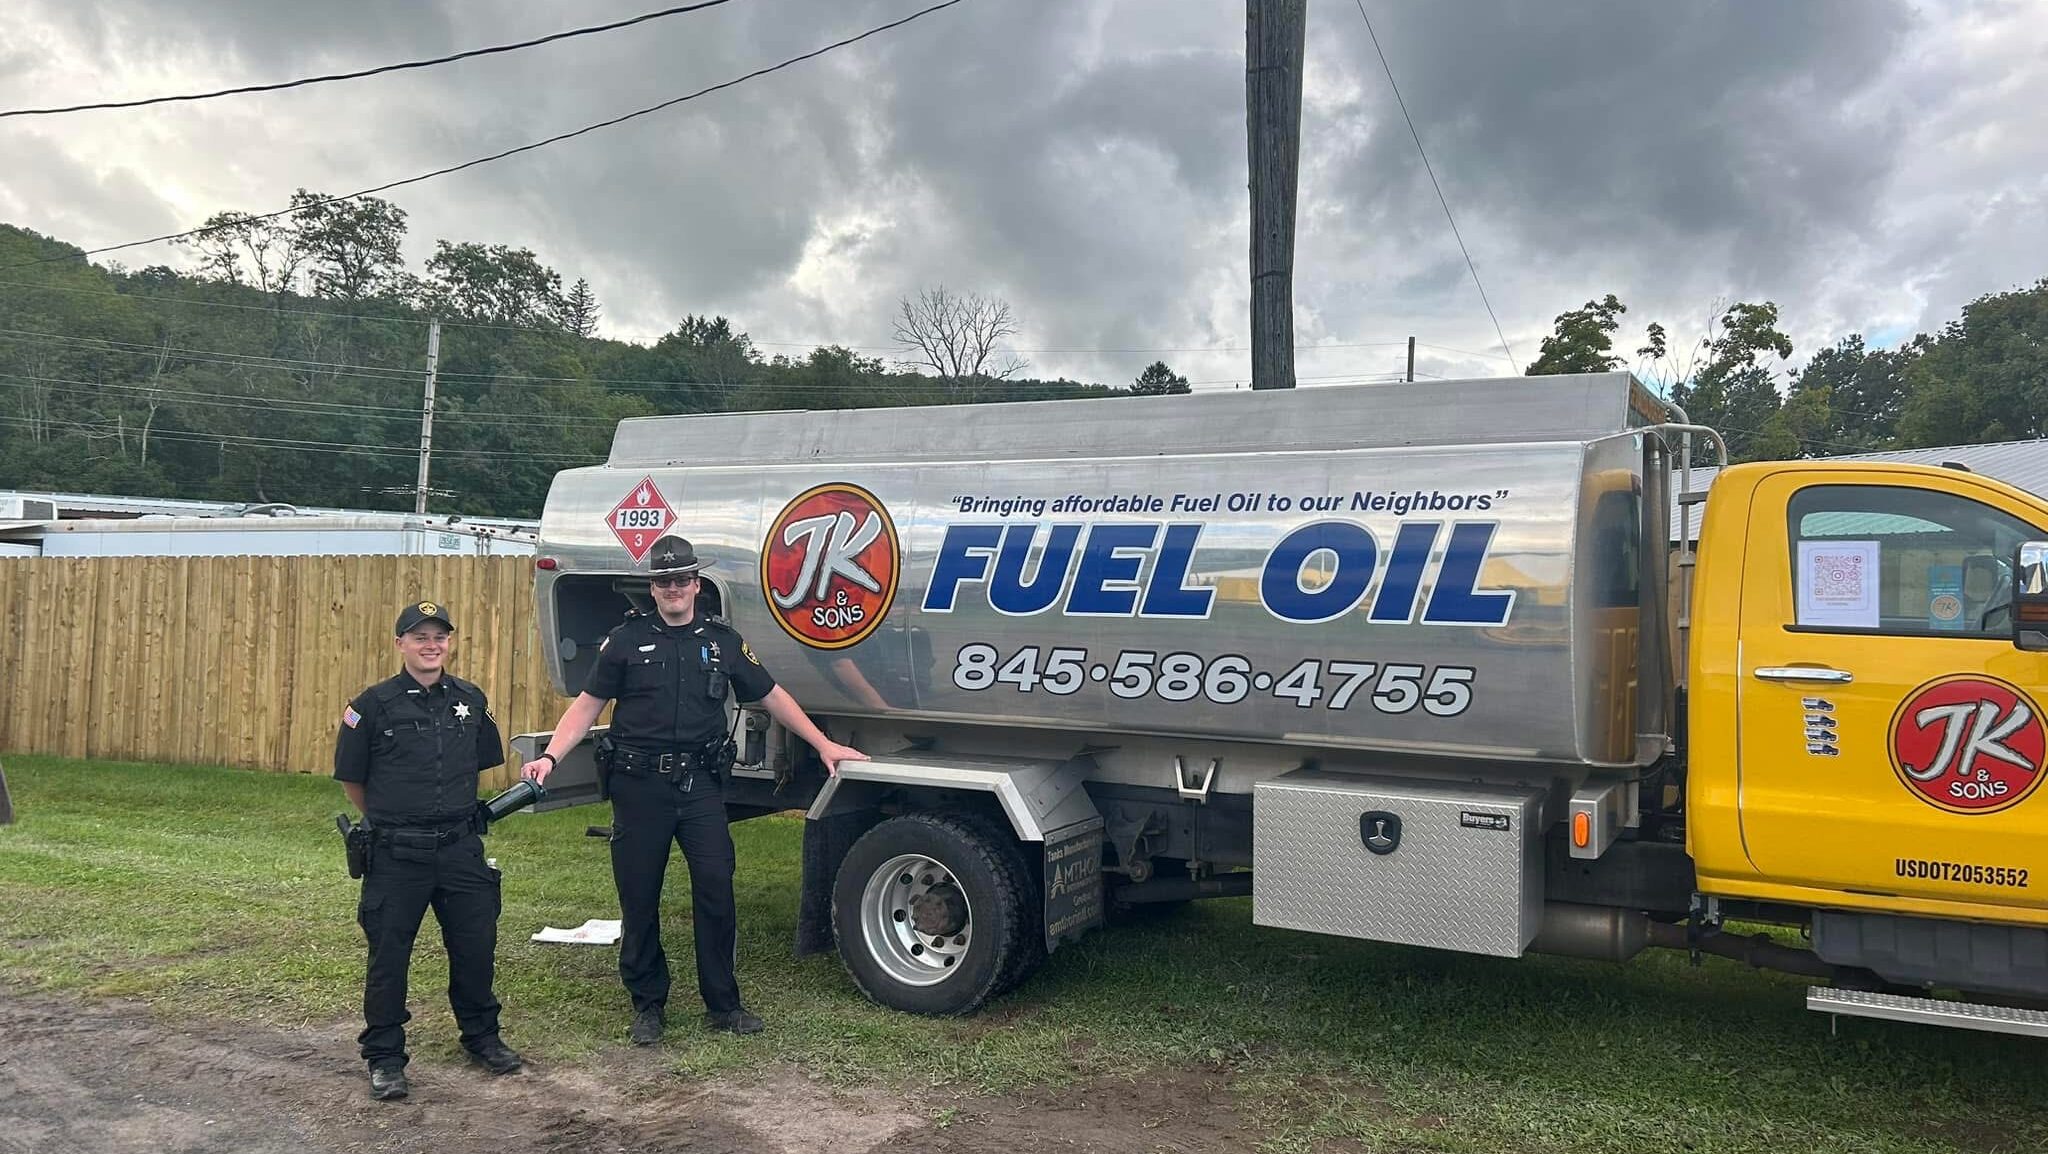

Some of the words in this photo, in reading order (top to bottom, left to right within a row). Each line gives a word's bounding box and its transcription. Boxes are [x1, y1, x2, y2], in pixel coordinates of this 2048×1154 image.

[1051, 494, 1164, 513] affordable
[1170, 493, 1221, 513] Fuel
[1227, 492, 1262, 512] Oil
[1267, 493, 1292, 512] to
[1299, 496, 1344, 512] our
[620, 510, 659, 527] 1993
[634, 533, 643, 548] 3
[771, 510, 883, 610] JK
[920, 521, 1218, 618] FUEL
[1258, 519, 1517, 627] OIL
[836, 591, 849, 606] &
[812, 605, 866, 629] SONS
[1902, 697, 2037, 783] JK
[1976, 769, 1990, 781] &
[1950, 780, 2009, 800] SONS
[1462, 812, 1495, 825] Buyers
[1896, 858, 2028, 888] USDOT2053552
